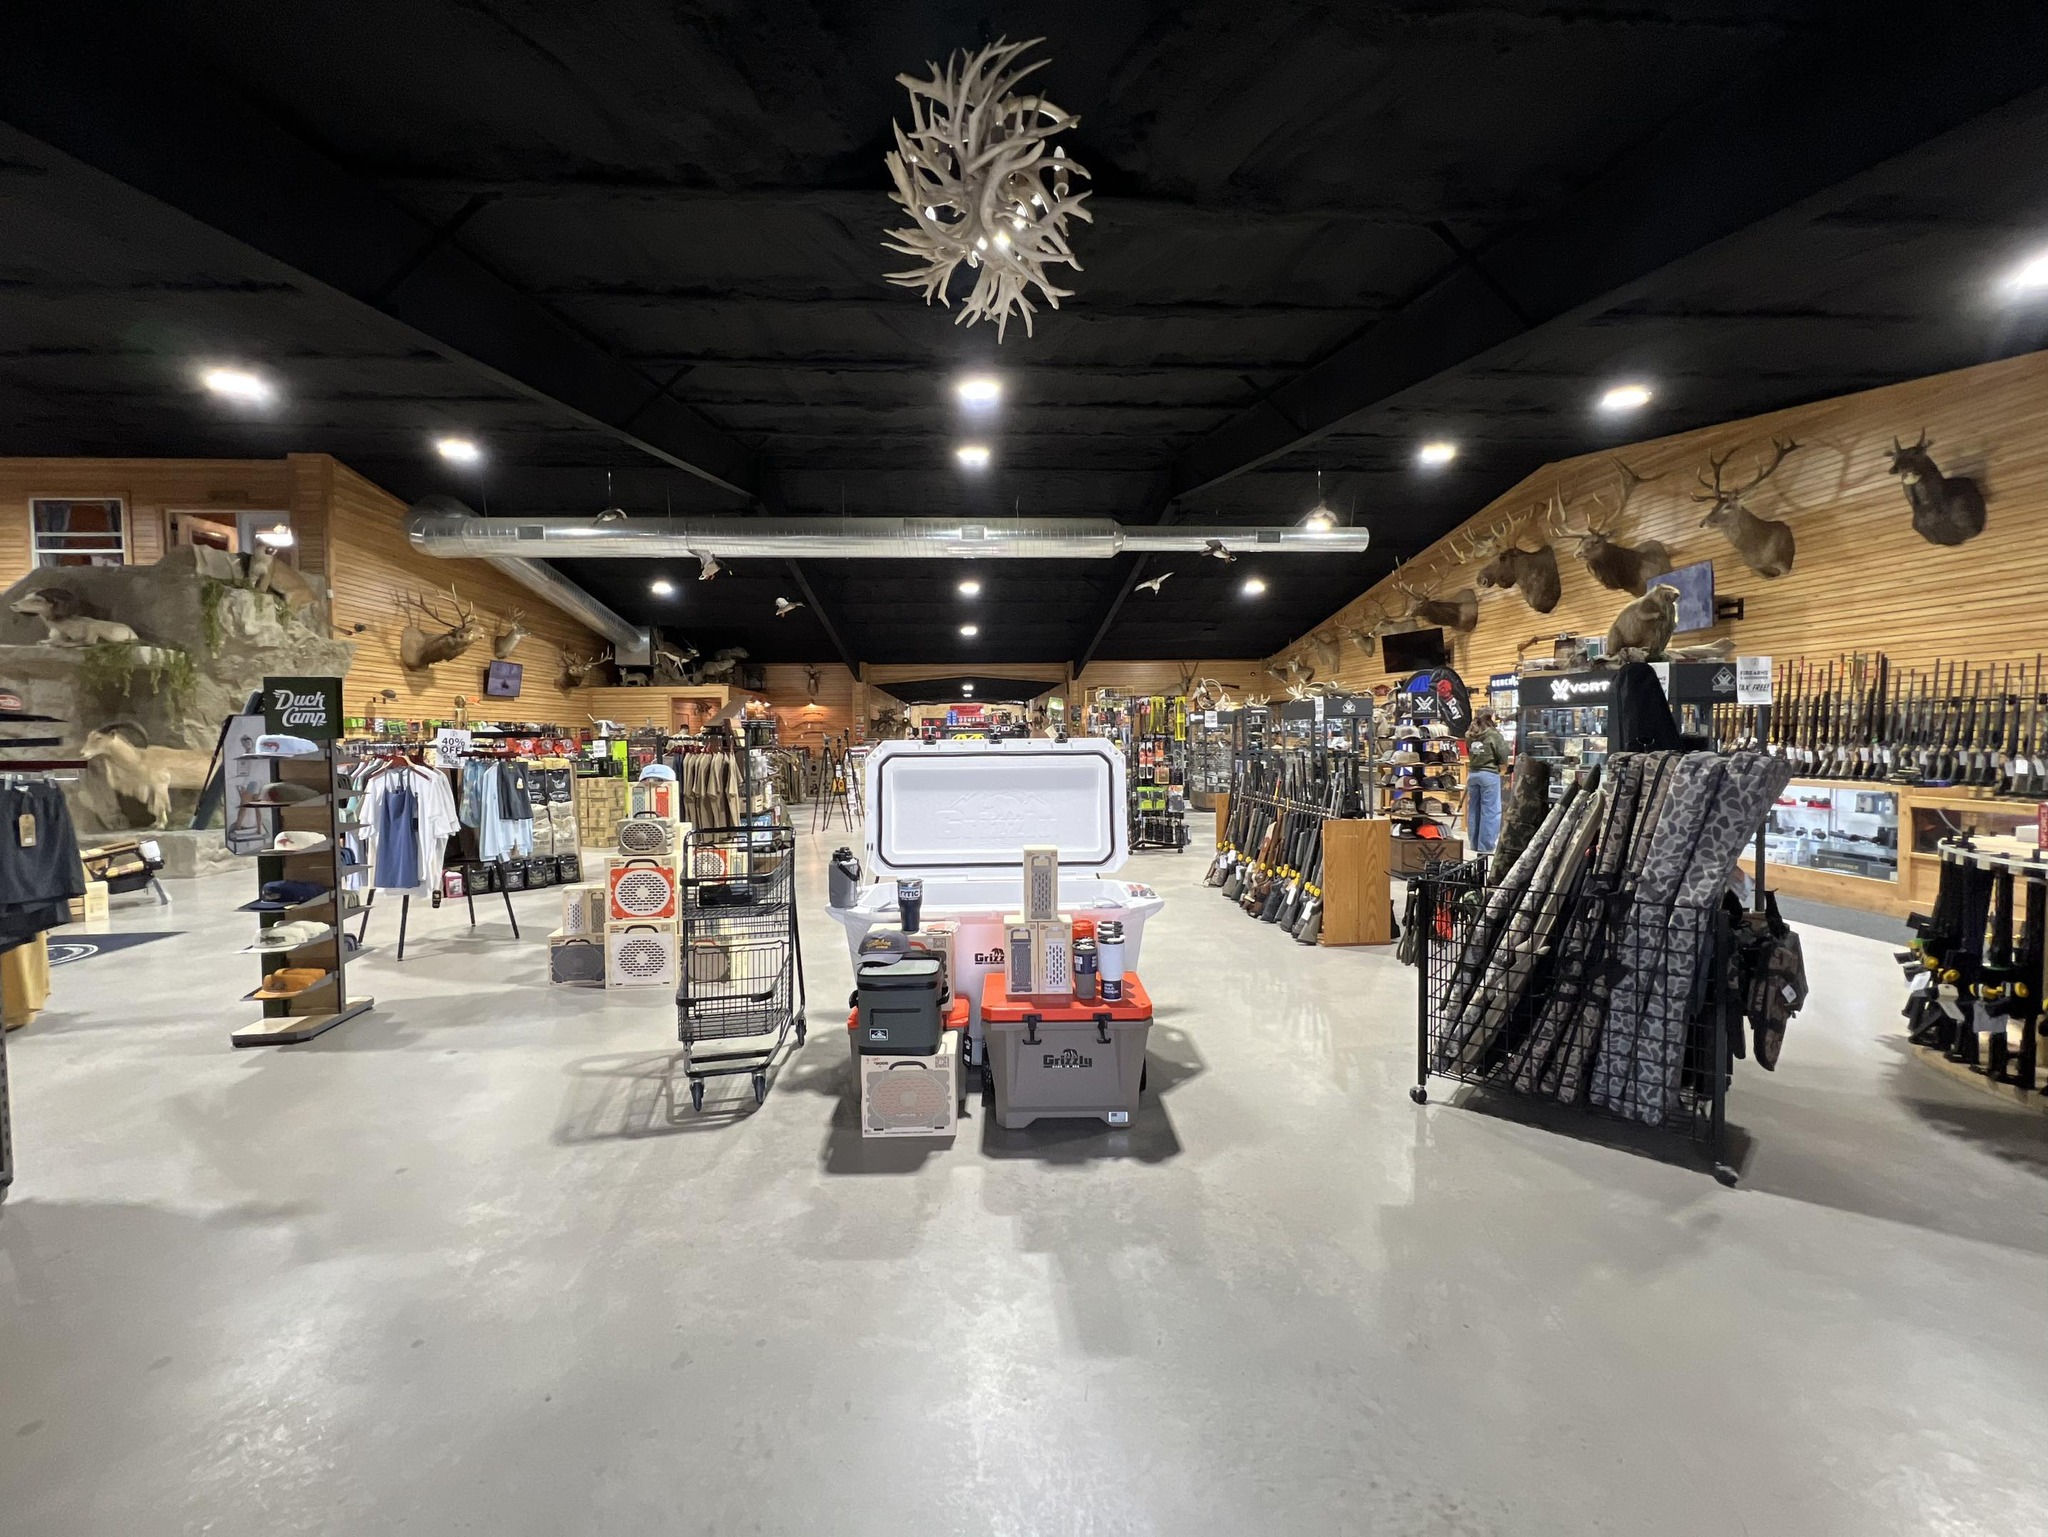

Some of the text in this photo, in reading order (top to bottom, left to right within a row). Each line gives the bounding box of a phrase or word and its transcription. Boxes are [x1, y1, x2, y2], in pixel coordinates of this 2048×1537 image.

[1570, 681, 1610, 693] VORT
[1752, 683, 1770, 692] FREE!
[272, 689, 325, 710] Duck
[282, 707, 328, 727] Camp
[441, 737, 466, 747] 40%
[975, 953, 1005, 962] Grizz
[1043, 1055, 1092, 1067] Grizzly
